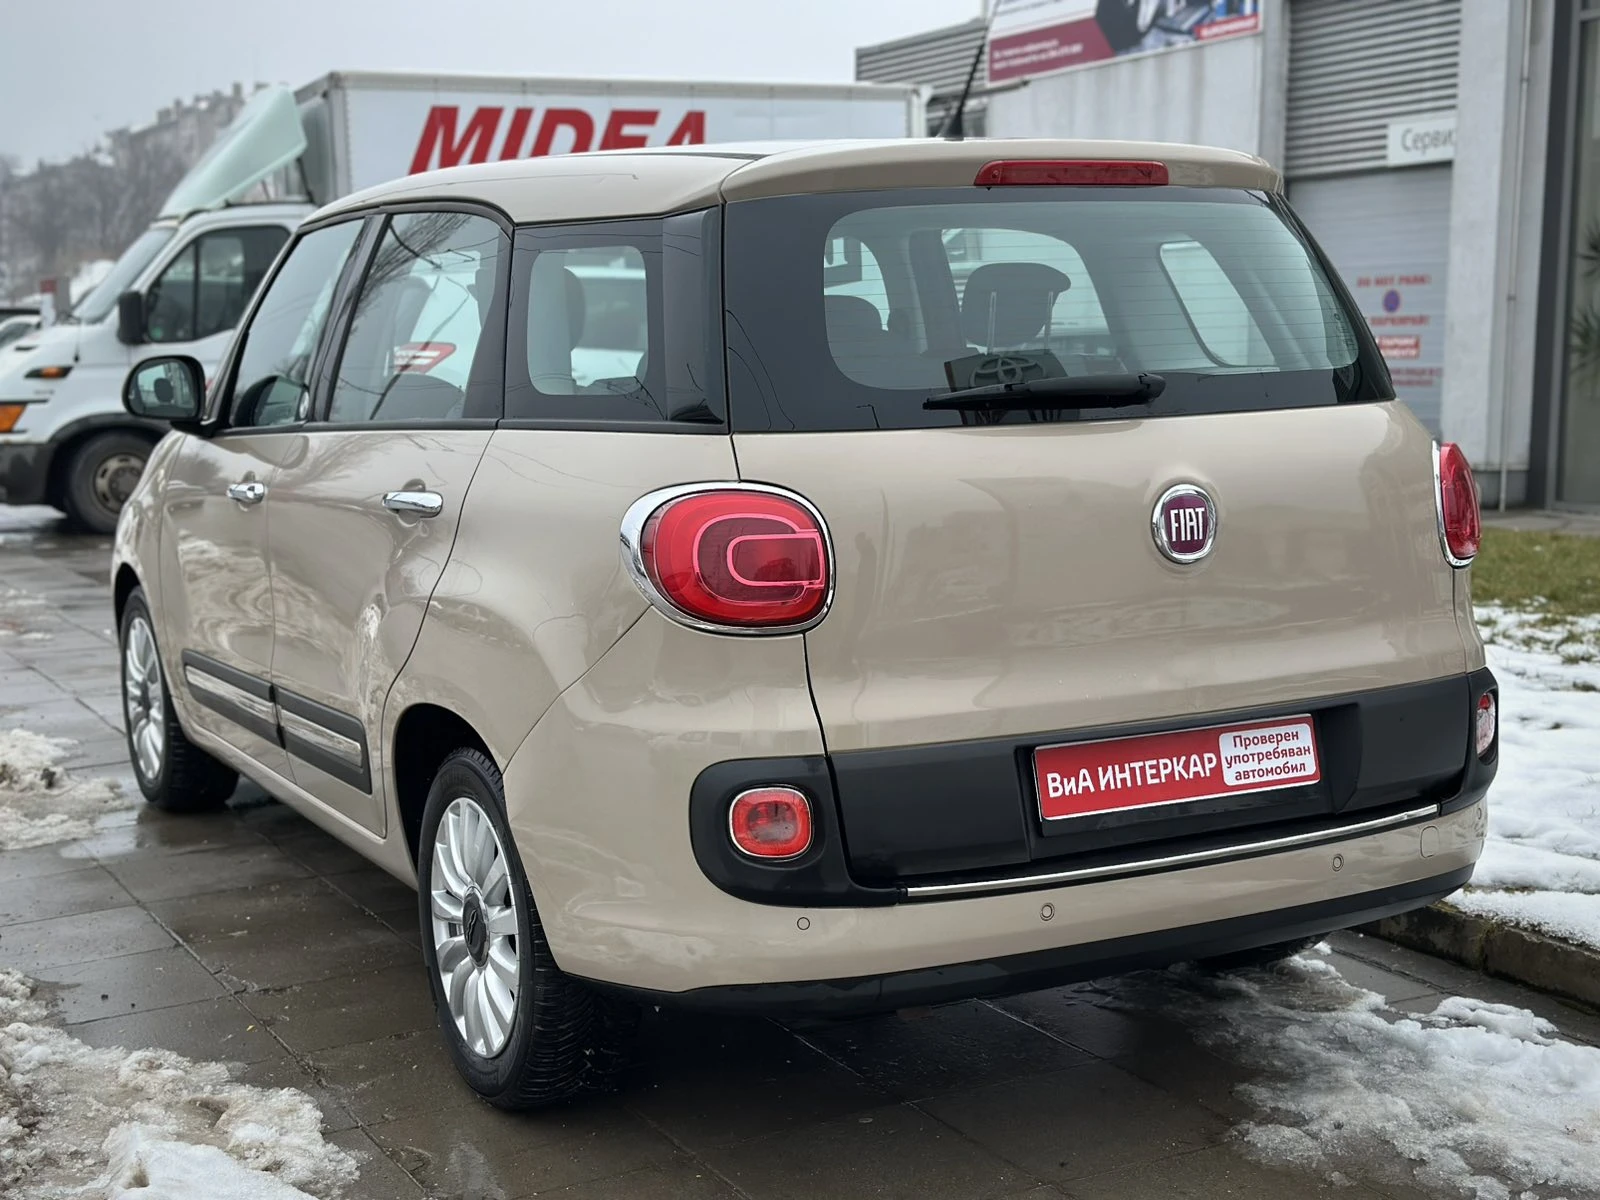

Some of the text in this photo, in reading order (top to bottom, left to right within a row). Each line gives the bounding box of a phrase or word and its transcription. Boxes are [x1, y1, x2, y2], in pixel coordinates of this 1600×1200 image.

[407, 106, 706, 175] MIDEA
[1401, 127, 1457, 156] Серви
[1170, 507, 1205, 542] FIAT
[1232, 730, 1300, 750] Проверен
[1224, 745, 1311, 769] употребяван
[1234, 761, 1307, 781] автомобил
[1046, 752, 1218, 798] ВиА ИНТЕРКАР
